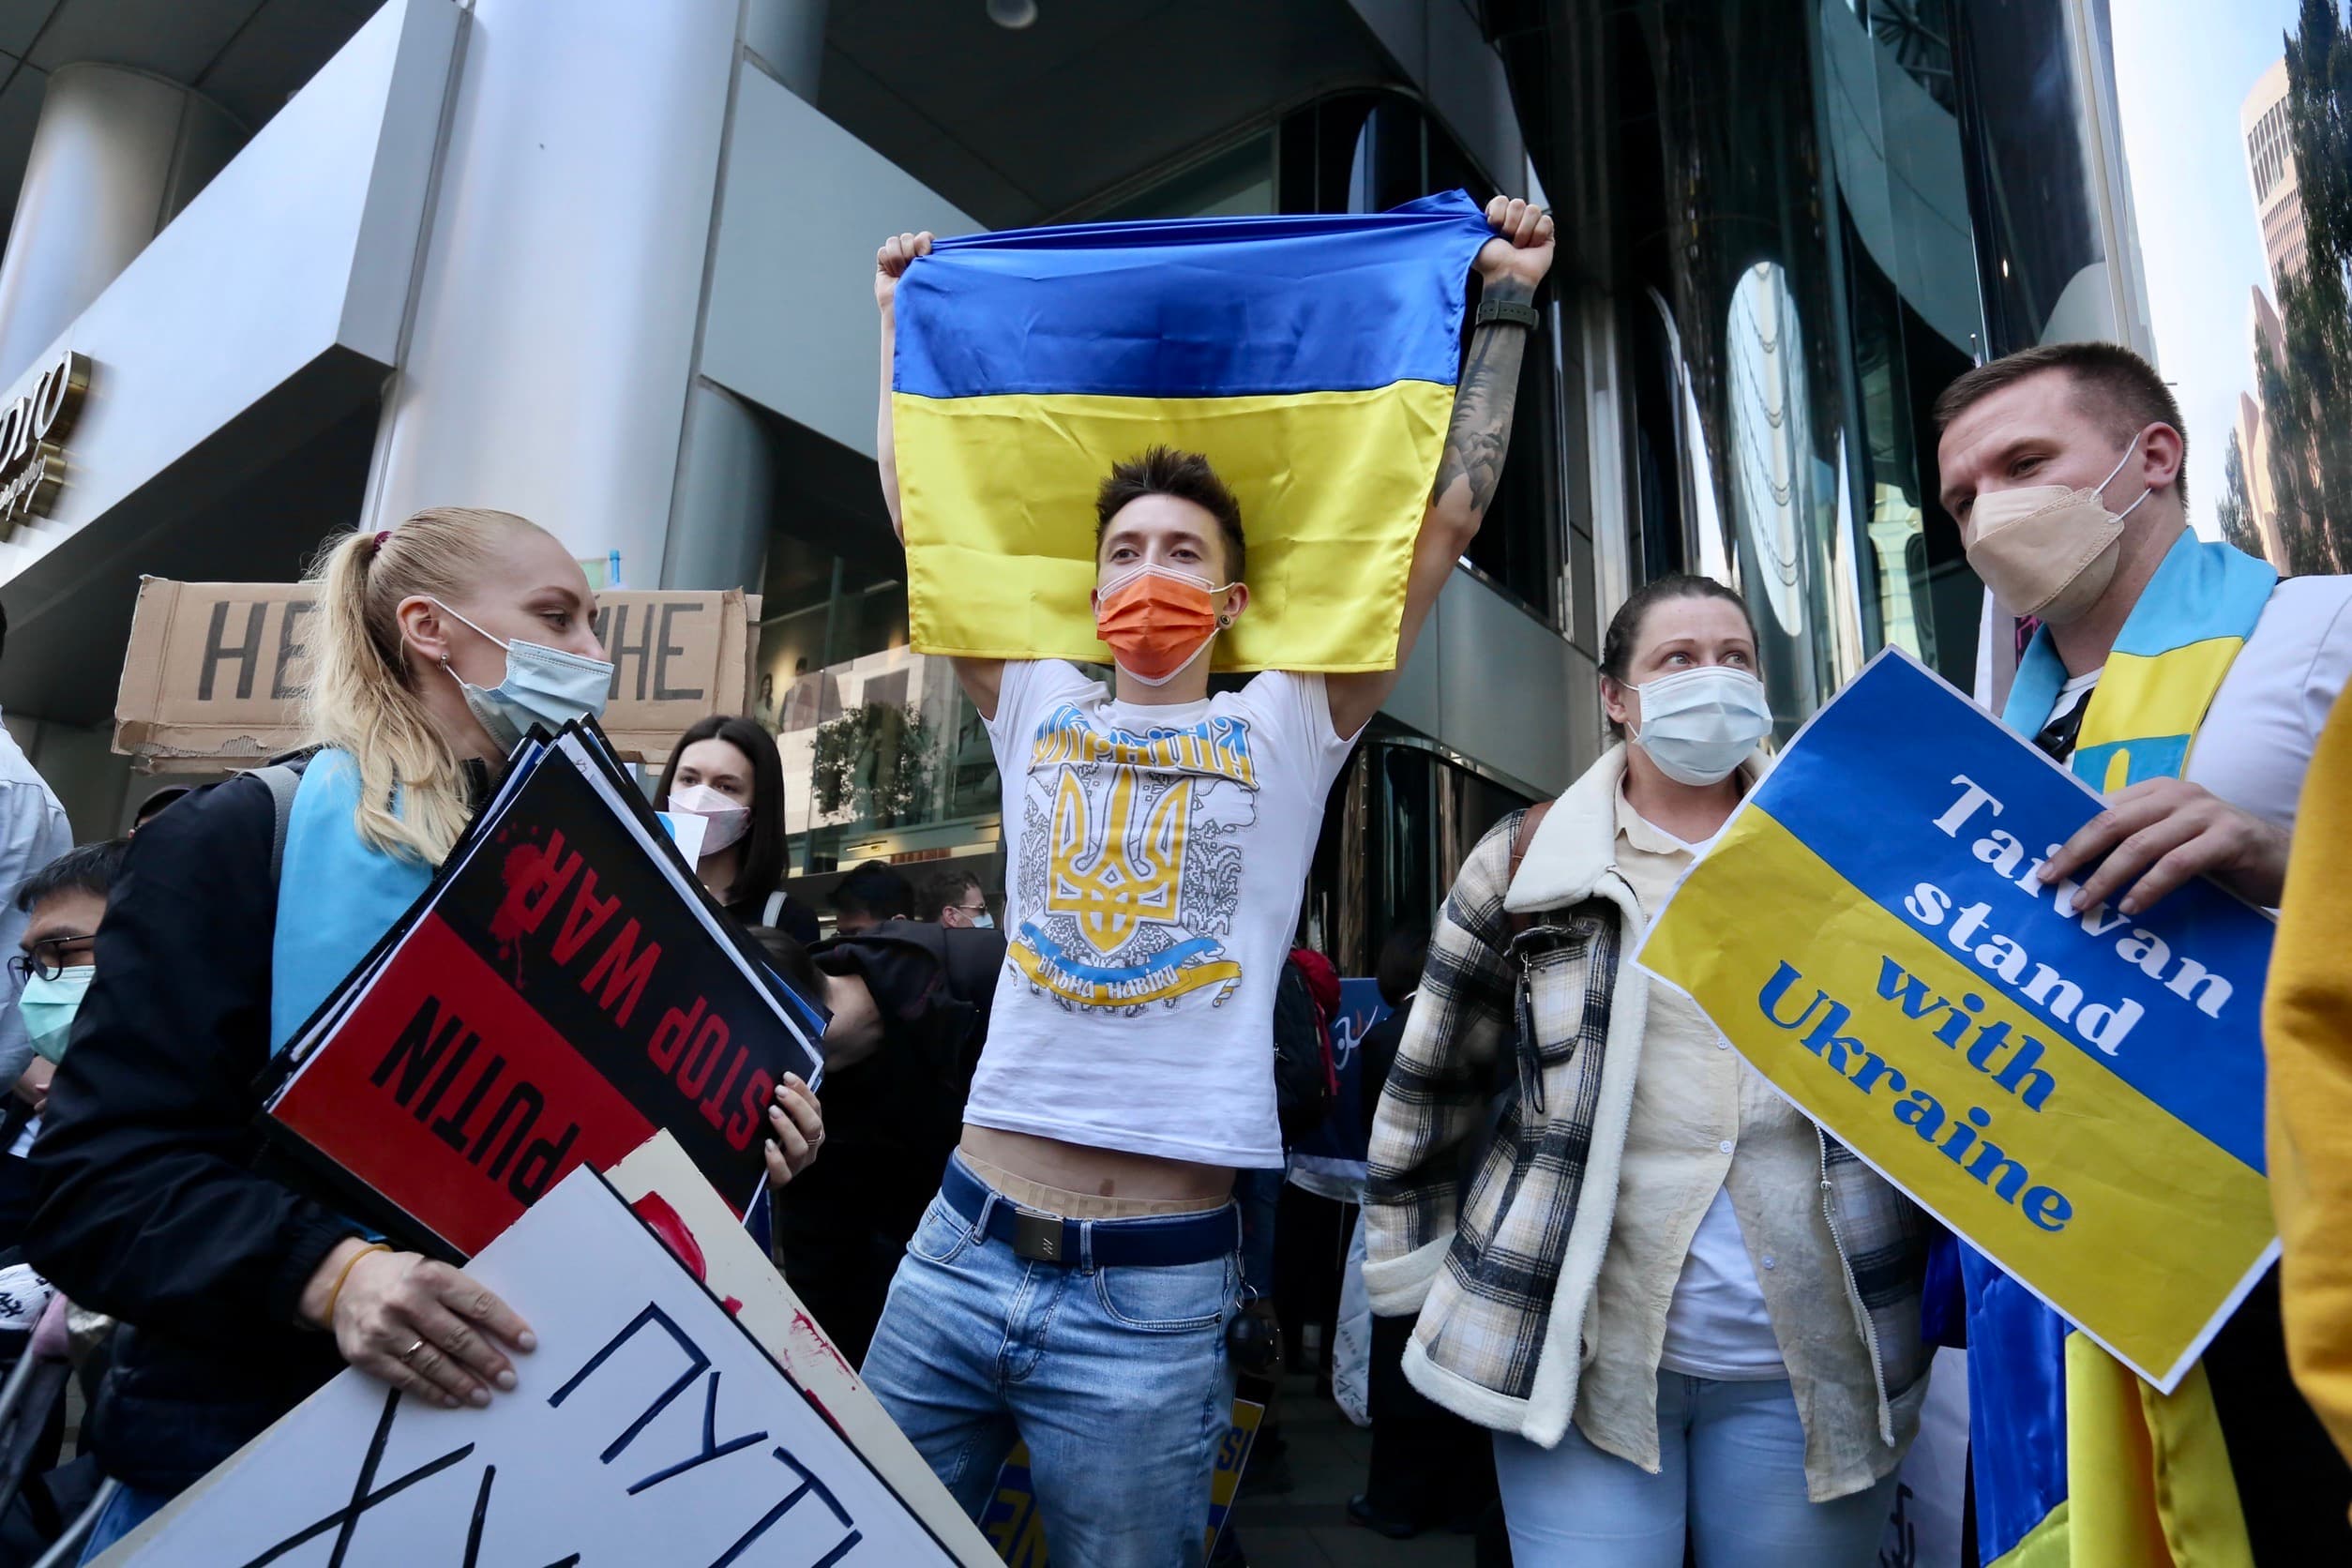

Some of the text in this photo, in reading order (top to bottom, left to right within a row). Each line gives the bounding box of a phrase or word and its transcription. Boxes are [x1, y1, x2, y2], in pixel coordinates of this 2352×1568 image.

[515, 828, 774, 1152] STOP WAR
[1904, 882, 2145, 1057] stand
[1932, 774, 2234, 1019] Taiwan
[369, 994, 580, 1209] PUTIN
[1756, 959, 2073, 1233] Ukraine
[1877, 955, 2058, 1113] with
[548, 1301, 863, 1568] ПУТ
